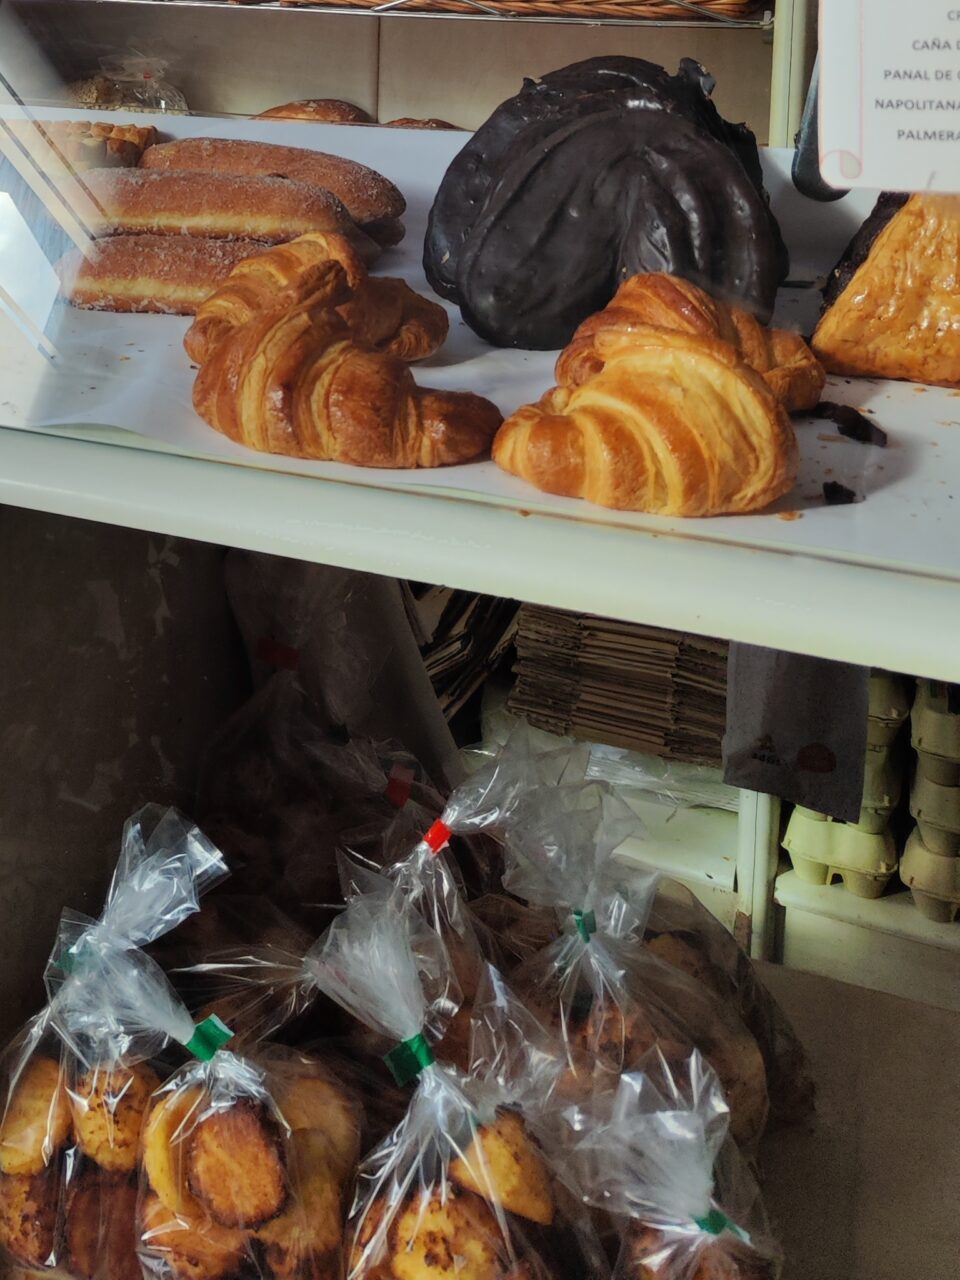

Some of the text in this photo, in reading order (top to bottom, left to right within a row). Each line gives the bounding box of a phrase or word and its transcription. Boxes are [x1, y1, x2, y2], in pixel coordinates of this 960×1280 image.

[911, 37, 952, 51] CAÑA
[883, 69, 930, 81] PANAL
[935, 70, 952, 81] DE
